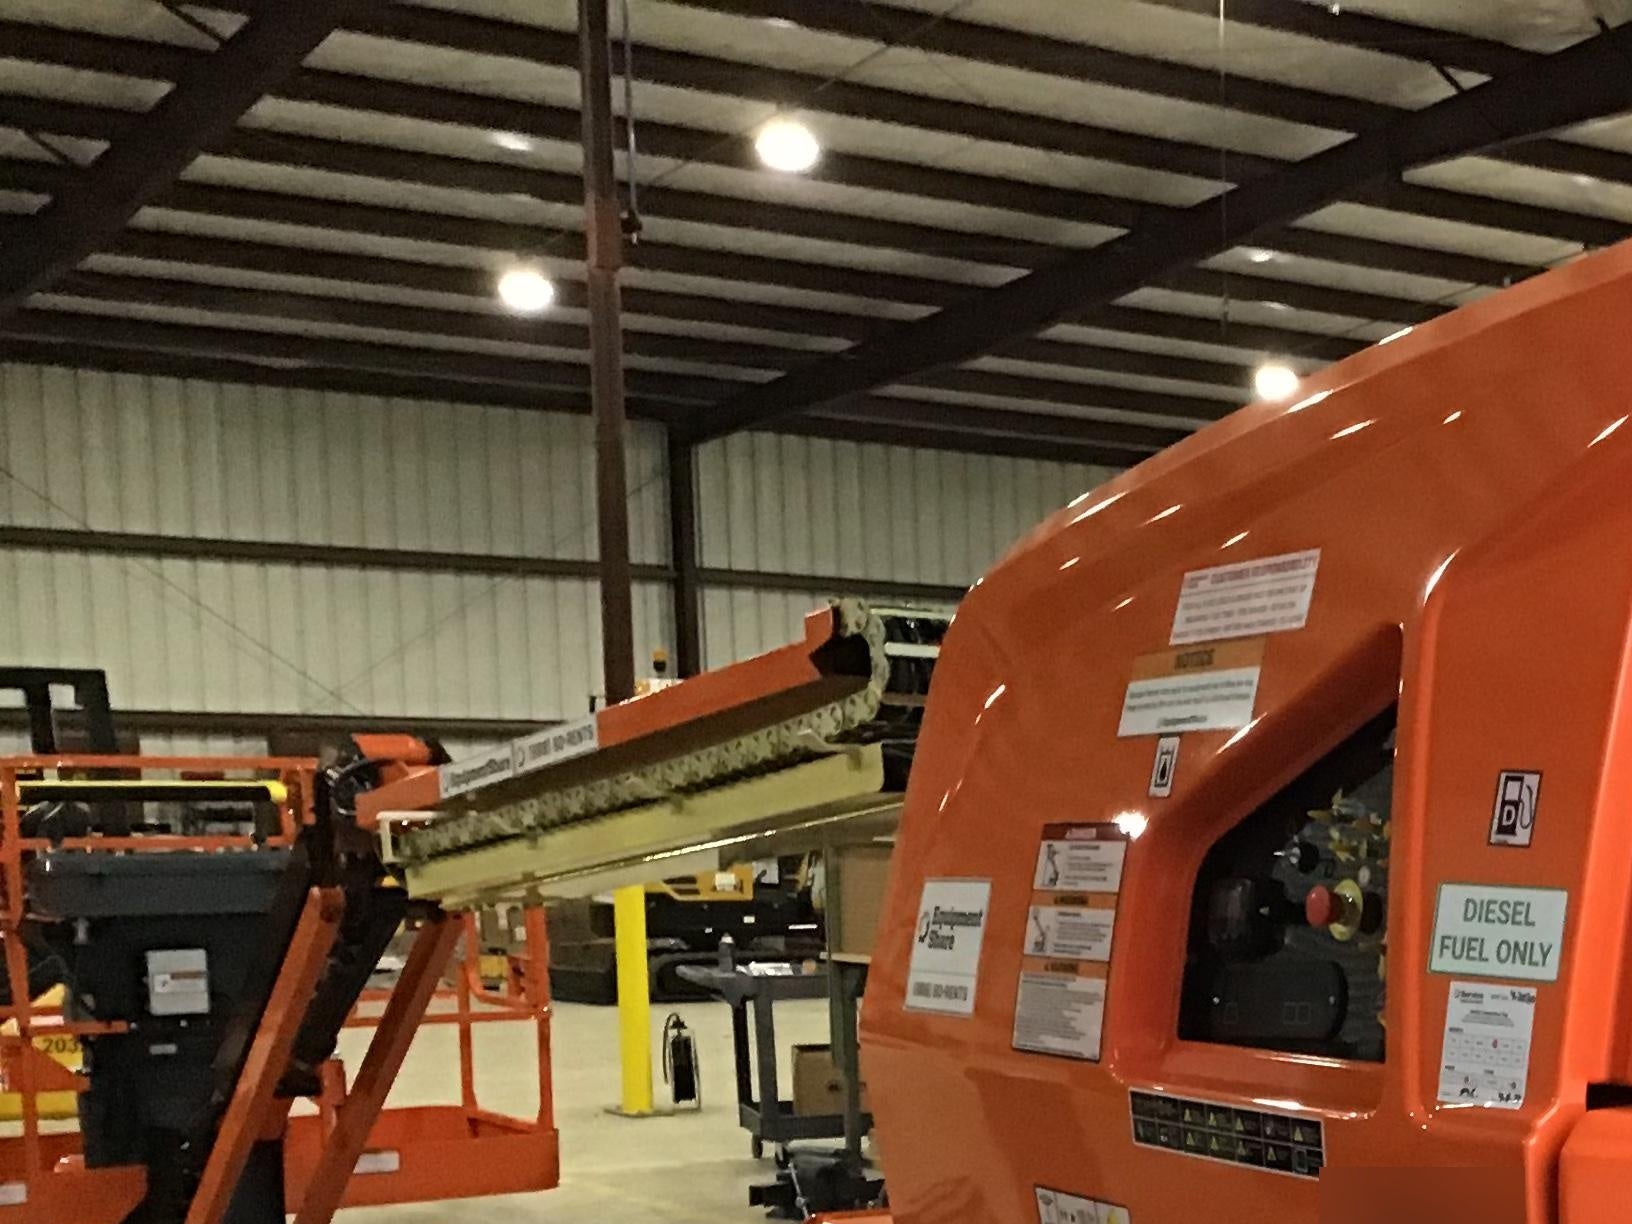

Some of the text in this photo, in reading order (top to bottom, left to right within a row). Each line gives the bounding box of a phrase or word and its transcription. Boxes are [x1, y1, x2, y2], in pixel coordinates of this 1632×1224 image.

[1463, 897, 1536, 927] DIESEL
[1439, 935, 1553, 967] FUEL ONLY
